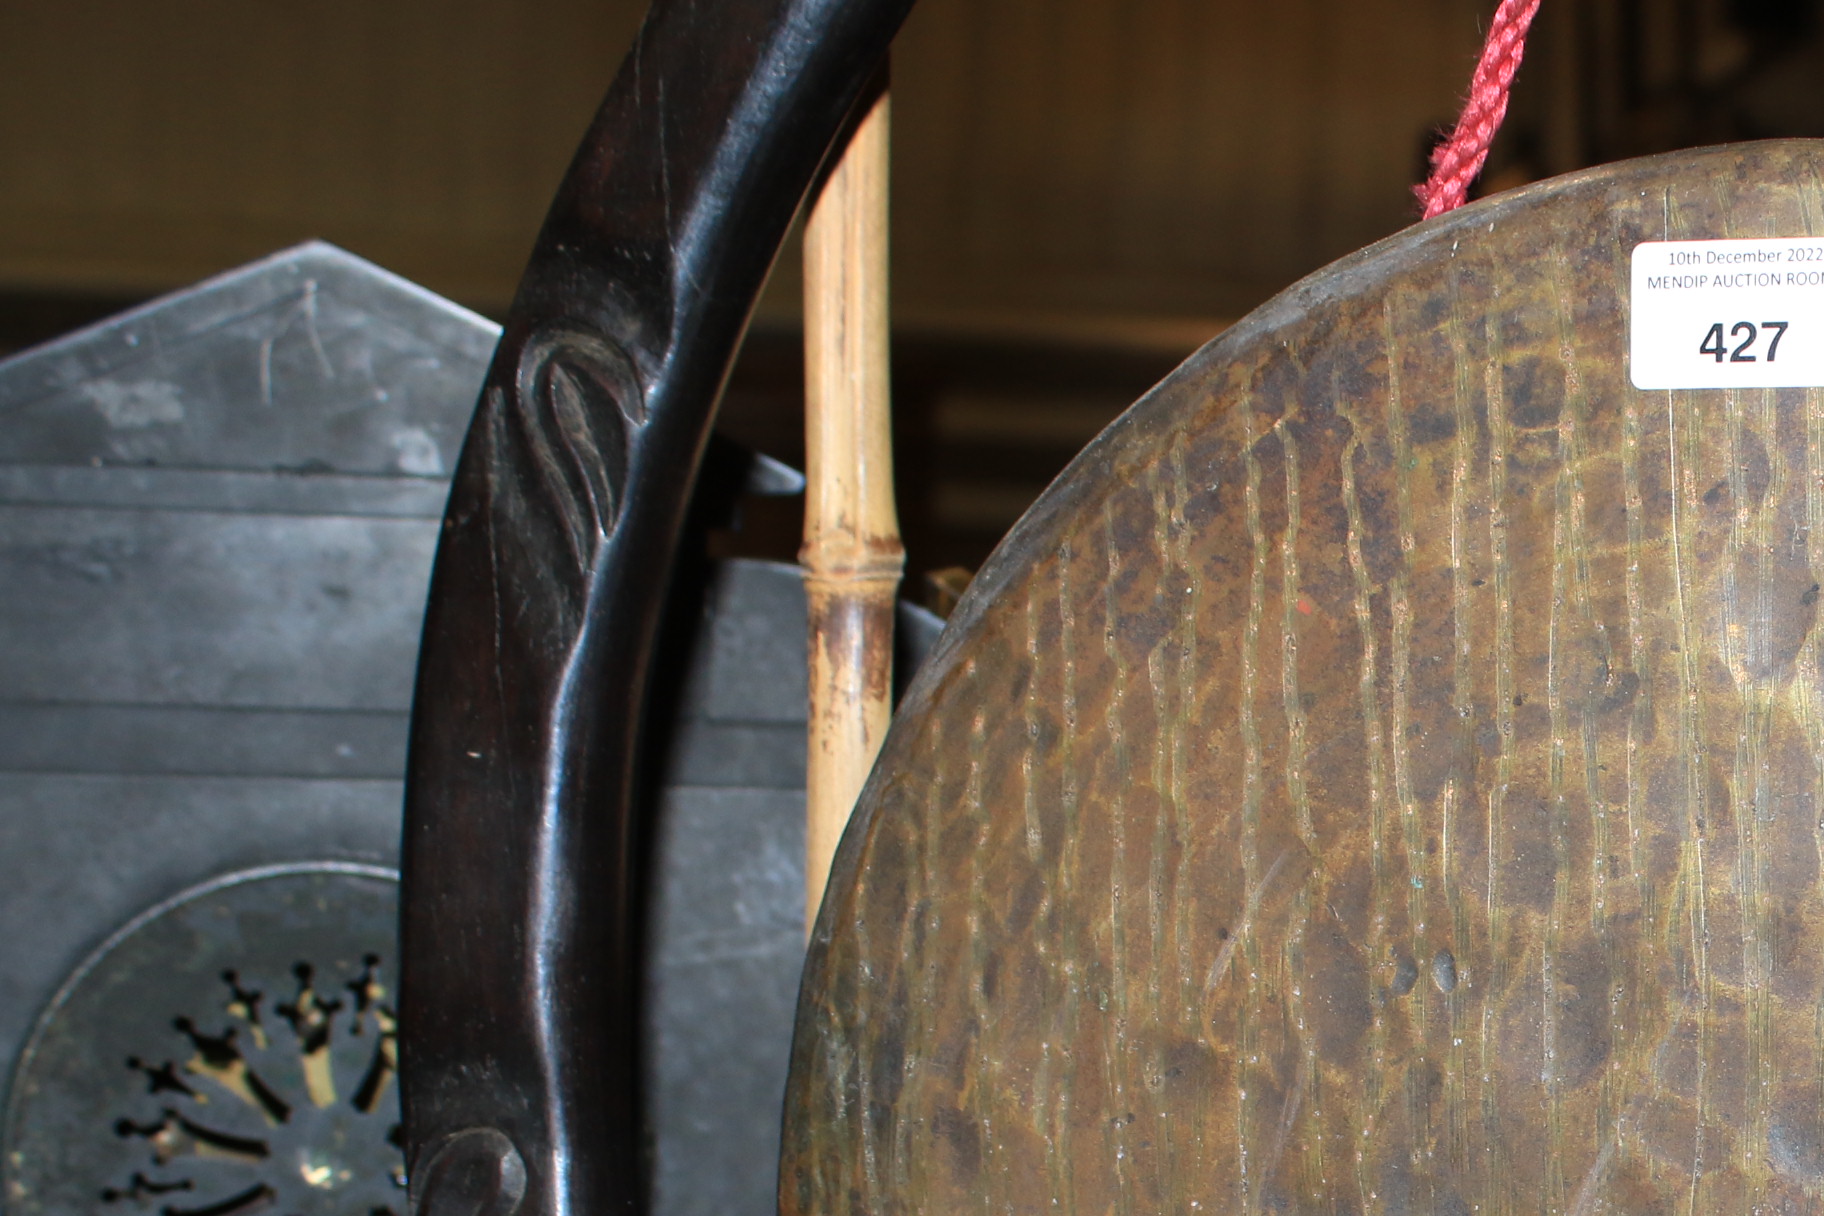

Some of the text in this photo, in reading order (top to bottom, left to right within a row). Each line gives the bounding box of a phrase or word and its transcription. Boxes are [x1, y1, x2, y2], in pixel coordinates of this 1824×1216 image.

[1669, 247, 1823, 265] 10th December 2022
[1647, 275, 1708, 289] MENDIP
[1713, 272, 1781, 288] AUCTION
[1699, 321, 1789, 363] 427
